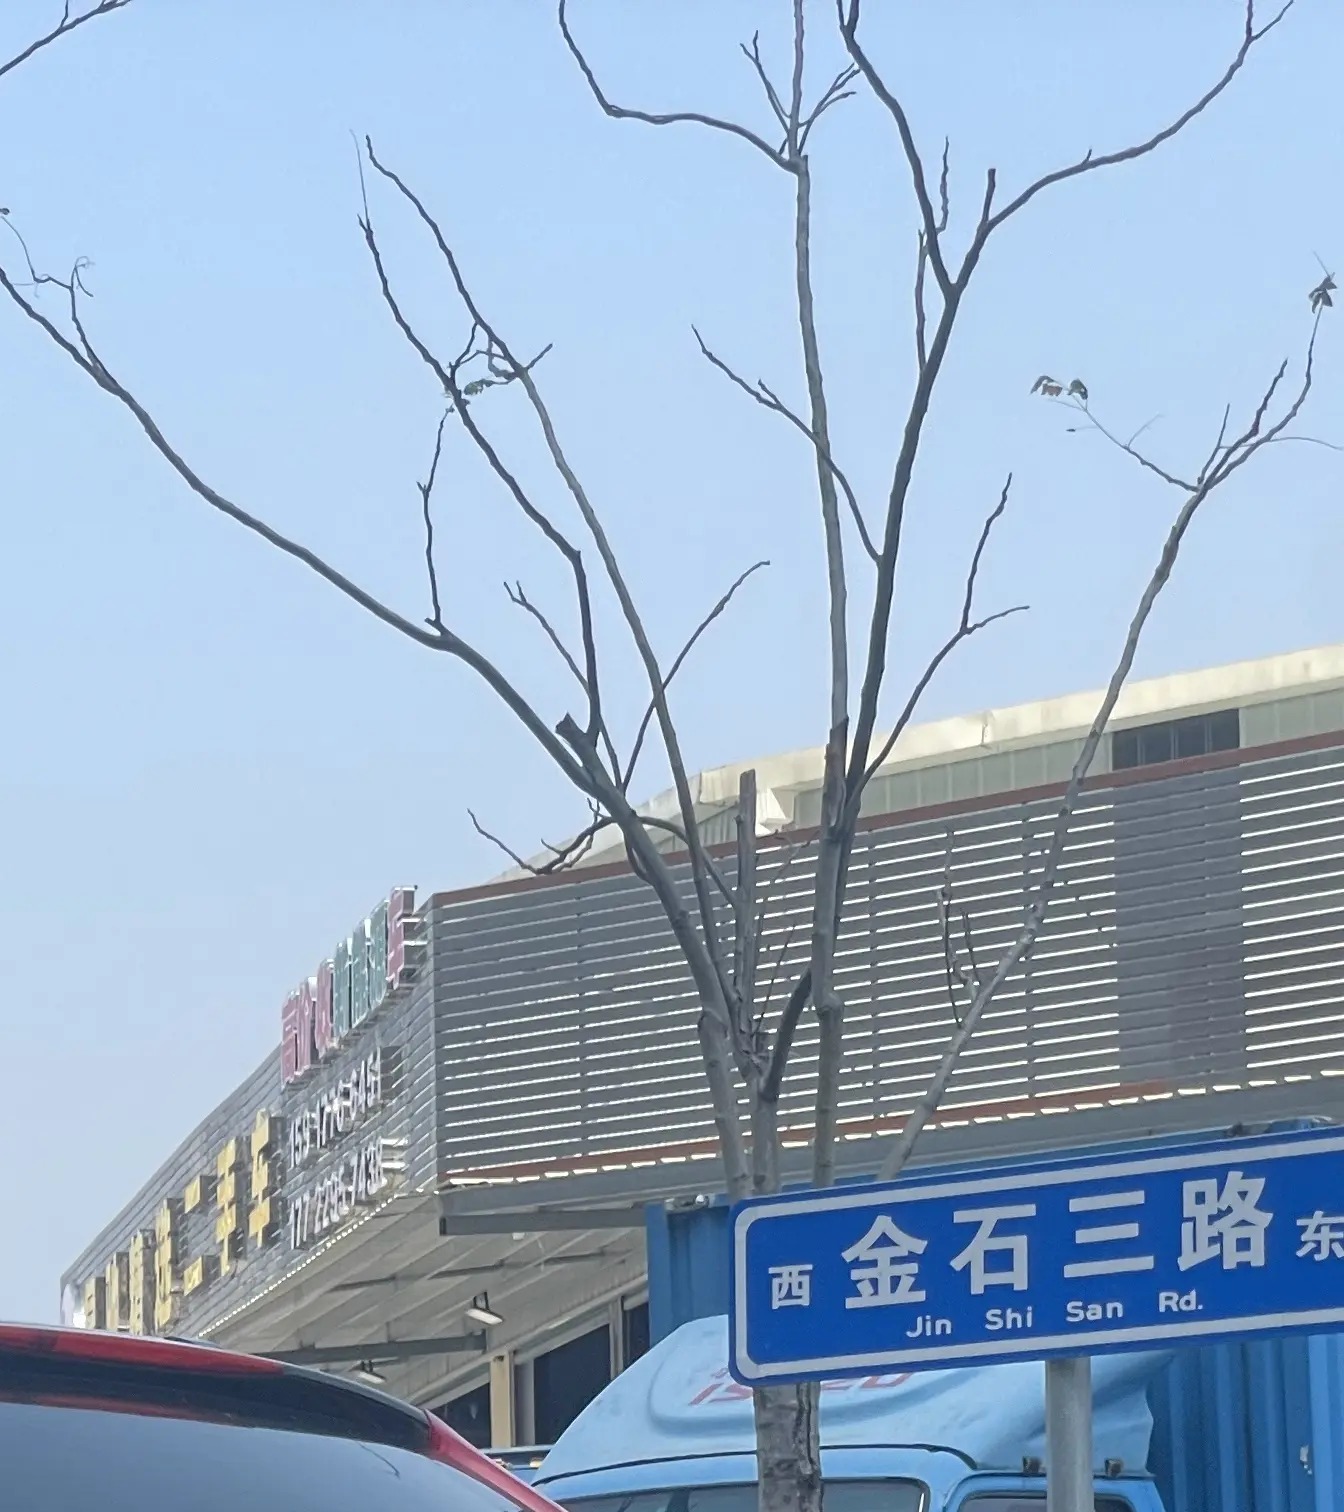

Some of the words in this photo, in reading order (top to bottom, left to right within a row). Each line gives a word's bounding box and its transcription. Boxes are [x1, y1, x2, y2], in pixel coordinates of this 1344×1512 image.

[841, 1171, 1274, 1309] 金石三路
[1296, 1210, 1344, 1261] 东
[768, 1264, 813, 1310] 西
[906, 1314, 952, 1338] Jin
[985, 1306, 1034, 1330] Shi
[1066, 1302, 1124, 1322] San
[1159, 1289, 1204, 1313] Rd.
